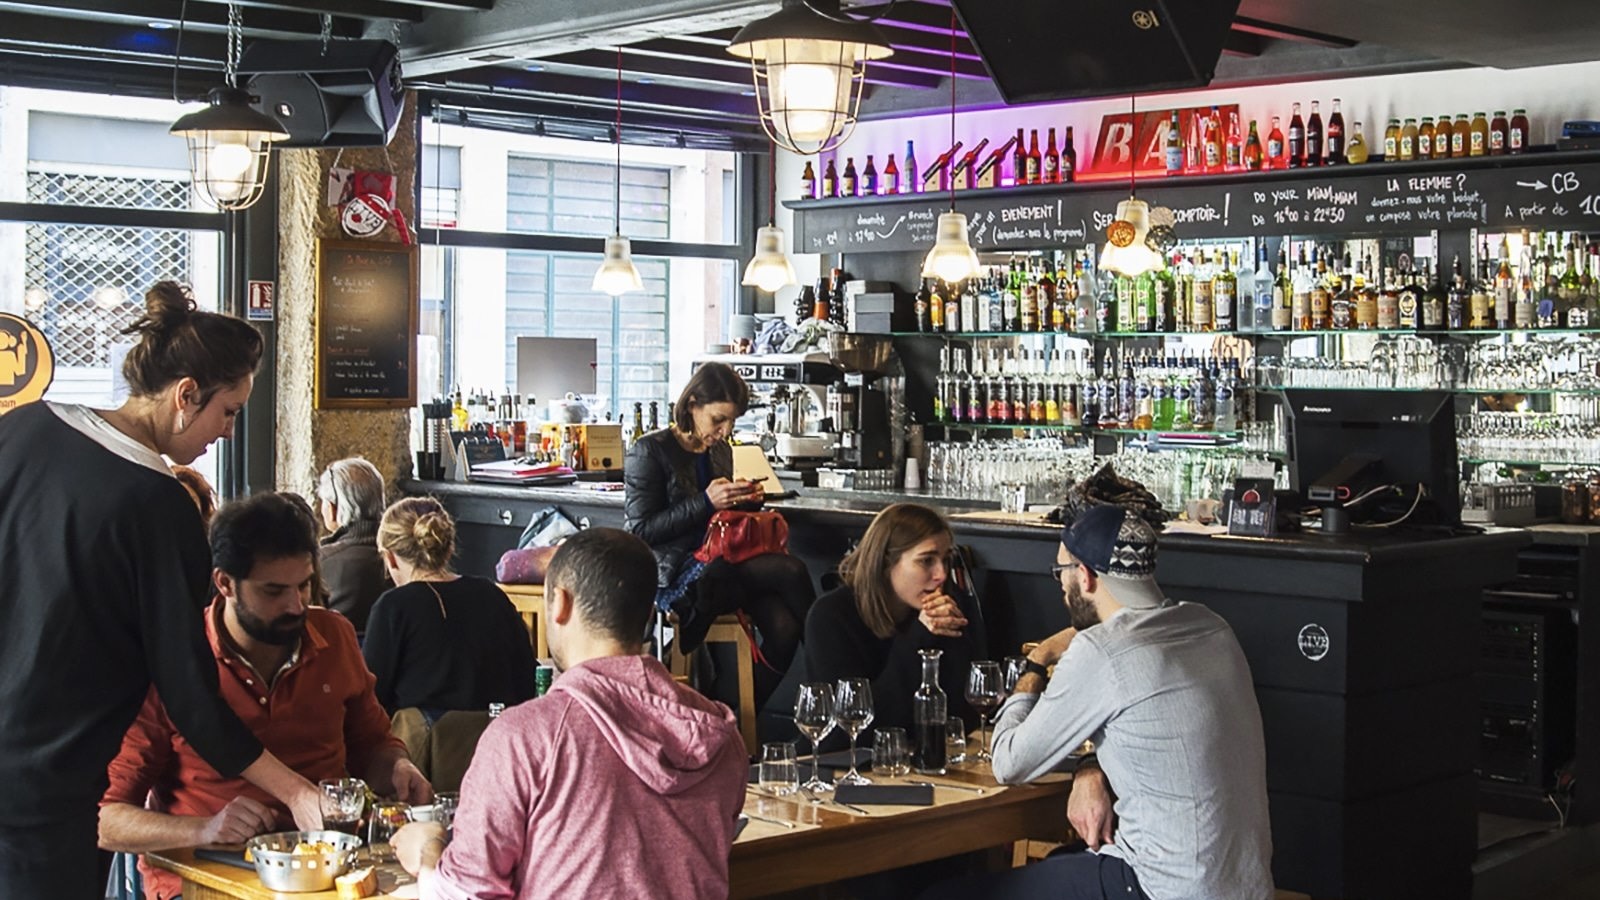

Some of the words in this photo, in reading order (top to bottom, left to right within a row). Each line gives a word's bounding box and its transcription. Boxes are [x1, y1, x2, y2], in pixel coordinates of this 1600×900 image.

[1386, 179, 1400, 192] LA
[1408, 176, 1452, 191] FLEMME
[1551, 171, 1580, 195] CB
[1371, 195, 1422, 207] donnez-nous
[1426, 192, 1446, 204] votre
[1001, 204, 1054, 222] EVENEMENT
[1379, 211, 1411, 224] compose
[1418, 207, 1440, 220] votre
[1504, 205, 1514, 218] A
[1519, 202, 1547, 221] partir
[1552, 202, 1569, 216] de
